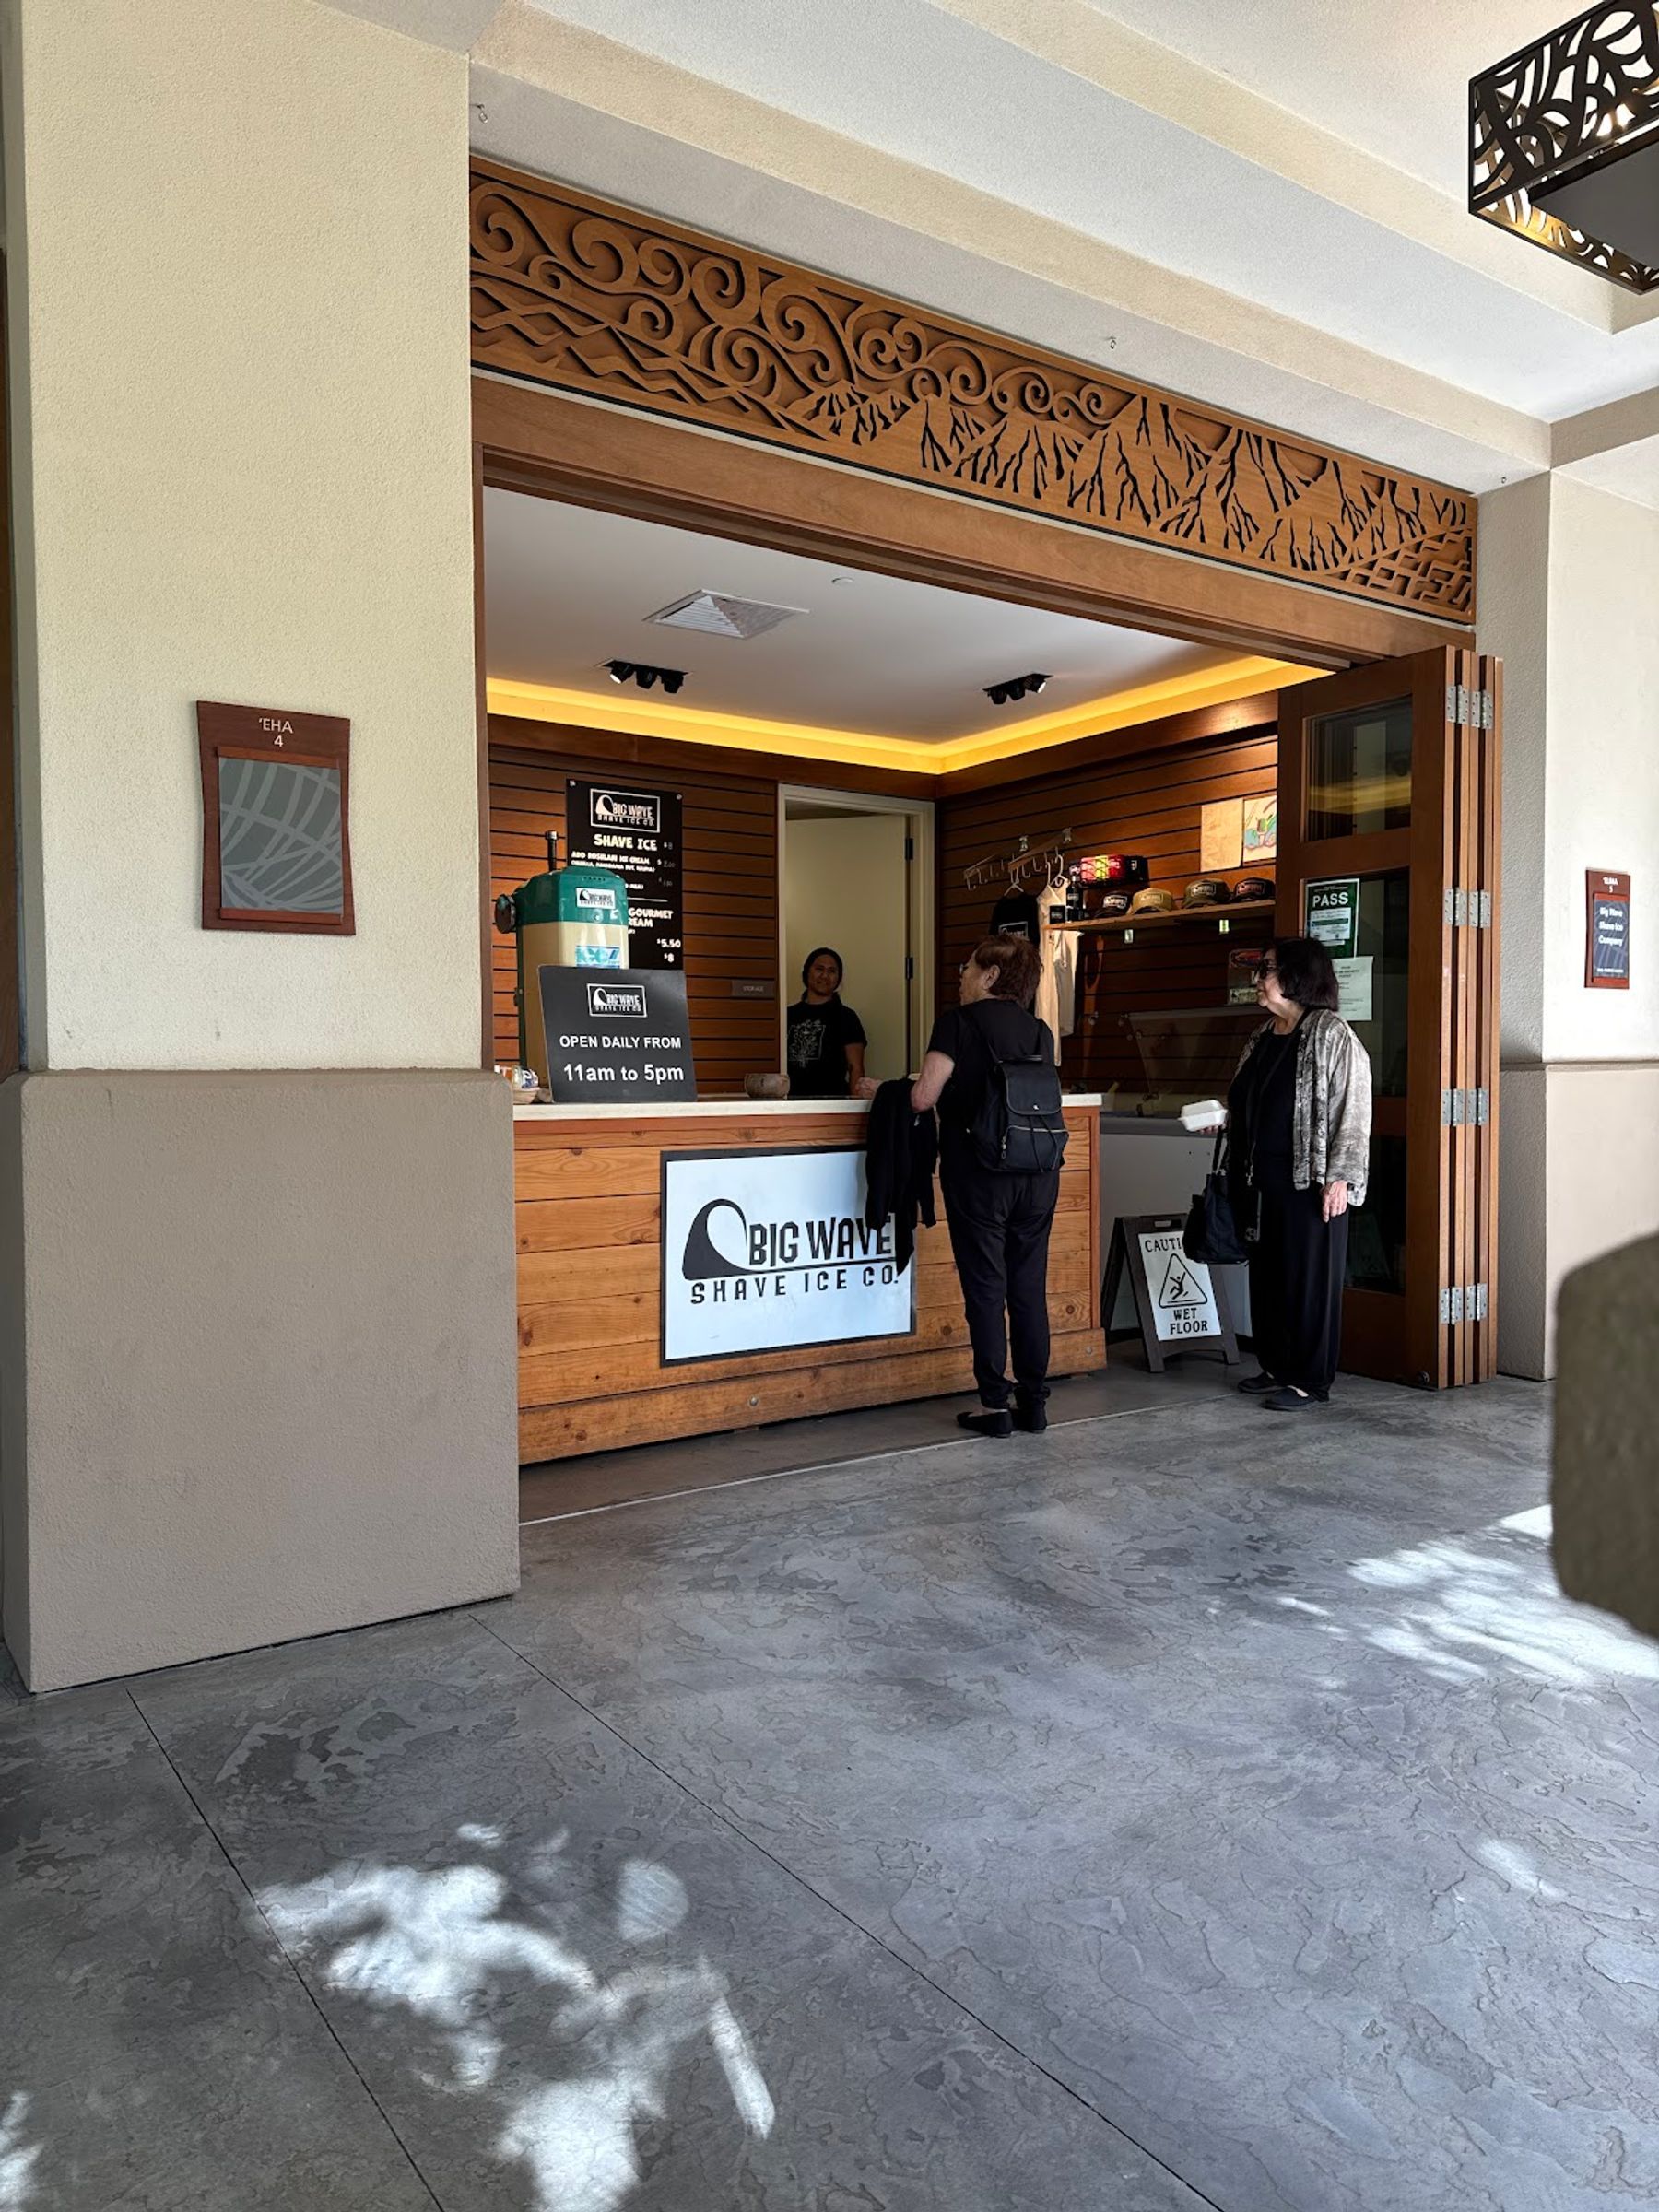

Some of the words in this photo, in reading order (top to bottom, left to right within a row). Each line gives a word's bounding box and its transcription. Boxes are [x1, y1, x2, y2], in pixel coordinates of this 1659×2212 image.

[274, 735, 284, 747] 4
[612, 803, 627, 816] BIG
[628, 804, 653, 818] WAVE
[627, 817, 640, 825] ICE
[594, 833, 633, 849] SHAVE
[637, 838, 657, 851] ICE
[571, 851, 586, 859] ADD
[1312, 891, 1349, 908] PASS
[628, 907, 674, 920] GOURMET
[628, 918, 653, 927] REAM
[657, 938, 681, 948] $5.50
[664, 953, 674, 963] $8
[606, 994, 618, 1005] BIG
[619, 994, 641, 1006] WAVE
[559, 1035, 598, 1048] OPEN
[602, 1036, 640, 1049] DAILY
[644, 1037, 682, 1049] FROM
[564, 1064, 616, 1081] 11am
[620, 1066, 638, 1081] to
[644, 1064, 684, 1085] 5pm
[749, 1221, 799, 1267] BIG
[806, 1216, 891, 1261] WAVE
[1145, 1238, 1182, 1253] CAUTI
[691, 1275, 786, 1305] SHAVE
[805, 1269, 847, 1293] ICE
[863, 1265, 899, 1287] CO.
[1173, 1308, 1197, 1321] WET
[1170, 1320, 1208, 1335] FLOOR
